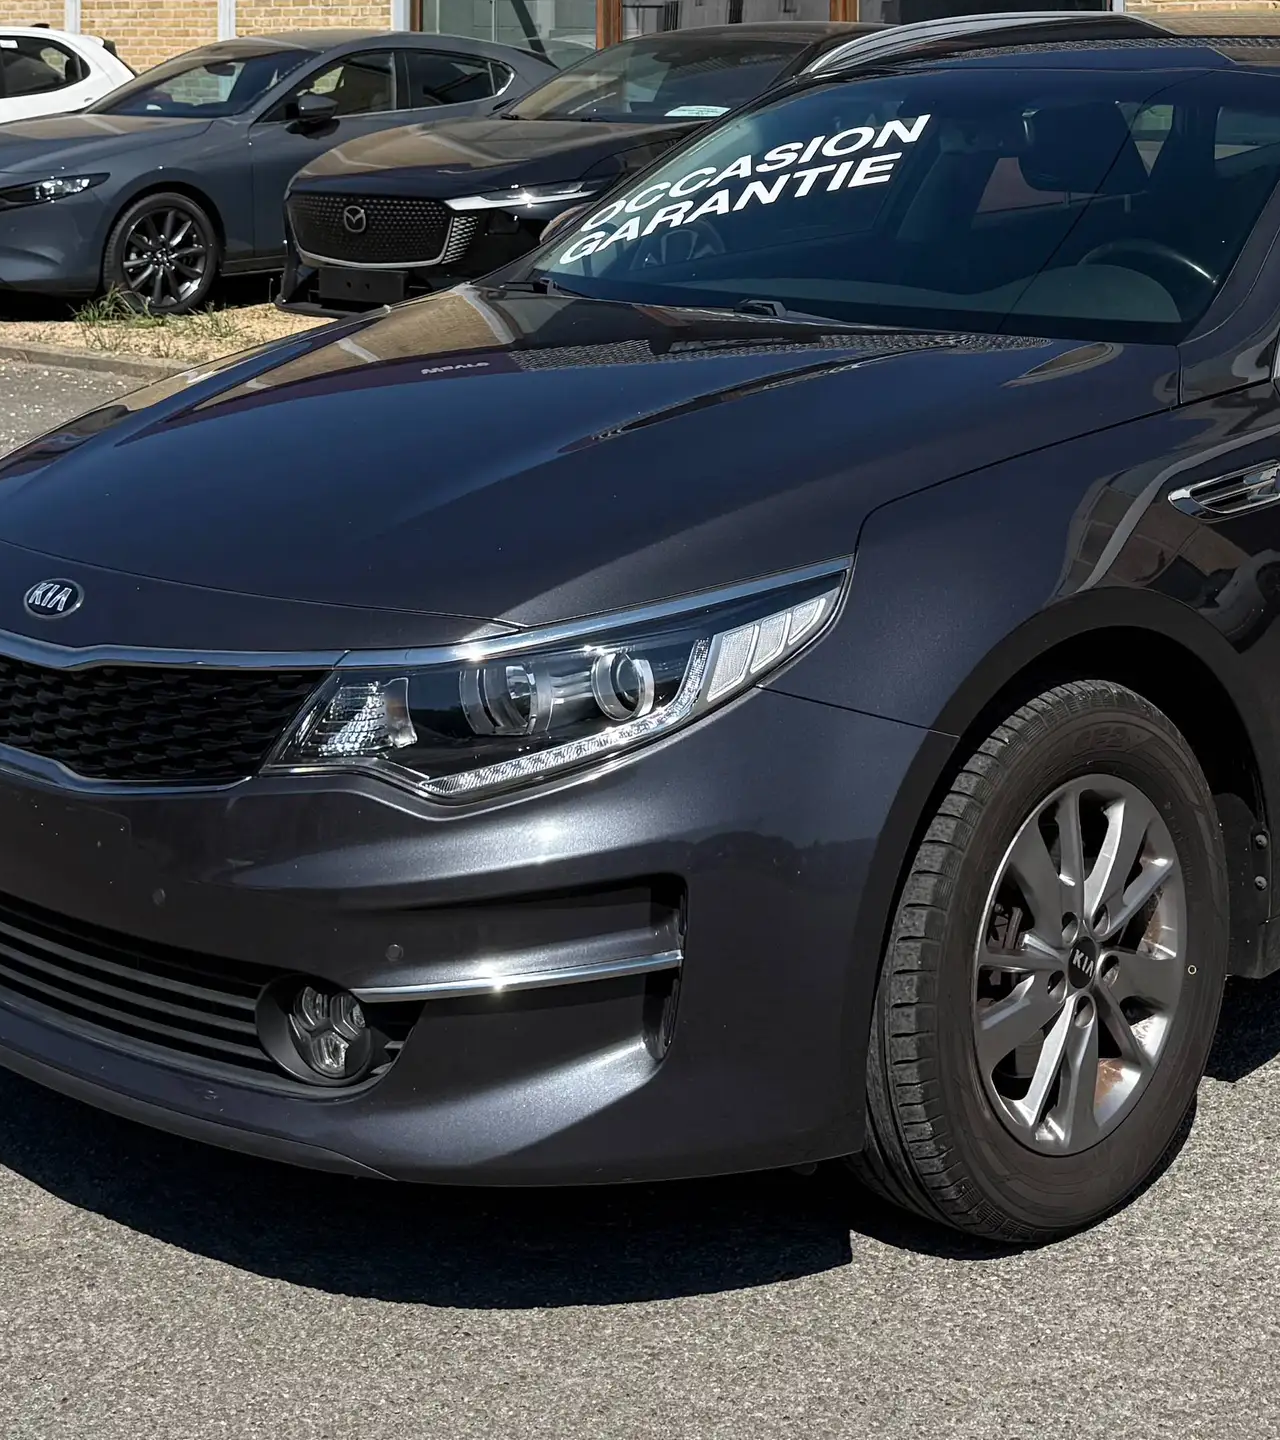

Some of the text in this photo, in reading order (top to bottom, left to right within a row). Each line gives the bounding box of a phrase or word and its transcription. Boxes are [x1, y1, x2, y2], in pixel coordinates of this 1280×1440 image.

[559, 152, 903, 265] GARANTIE
[580, 114, 931, 233] OCCASION
[28, 582, 73, 612] KIA
[1072, 949, 1095, 978] KIA
